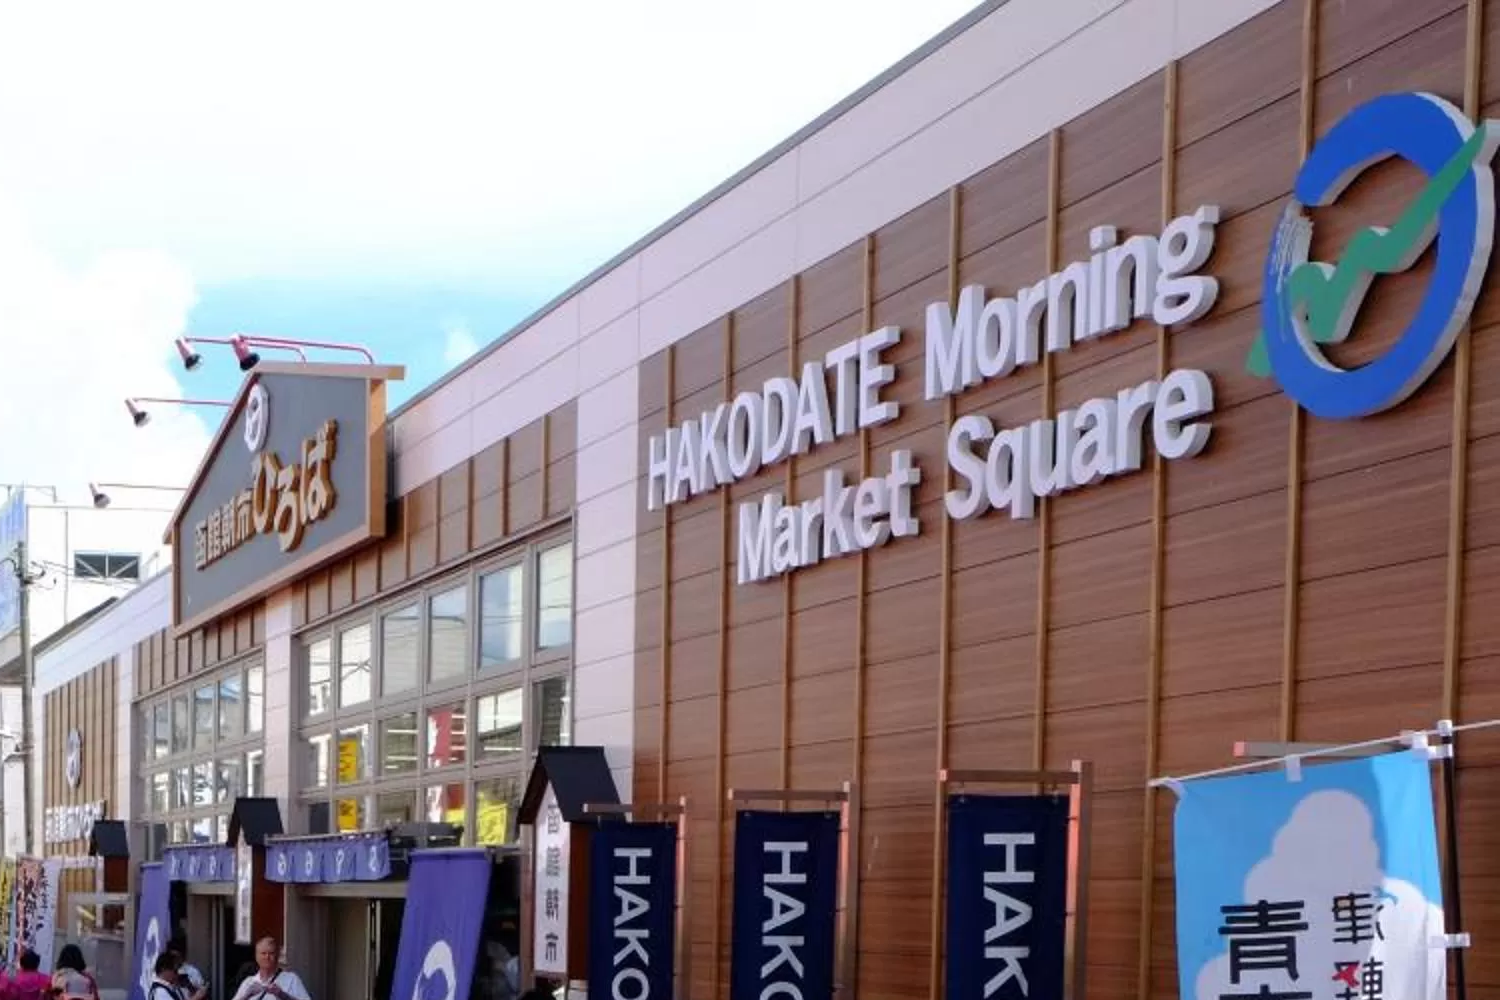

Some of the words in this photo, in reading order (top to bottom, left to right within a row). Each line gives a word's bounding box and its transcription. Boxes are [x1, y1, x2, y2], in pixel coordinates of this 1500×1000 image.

[647, 325, 902, 512] HAKODATE
[924, 203, 1221, 401] Morning
[736, 448, 922, 585] Market
[944, 367, 1216, 521] Square
